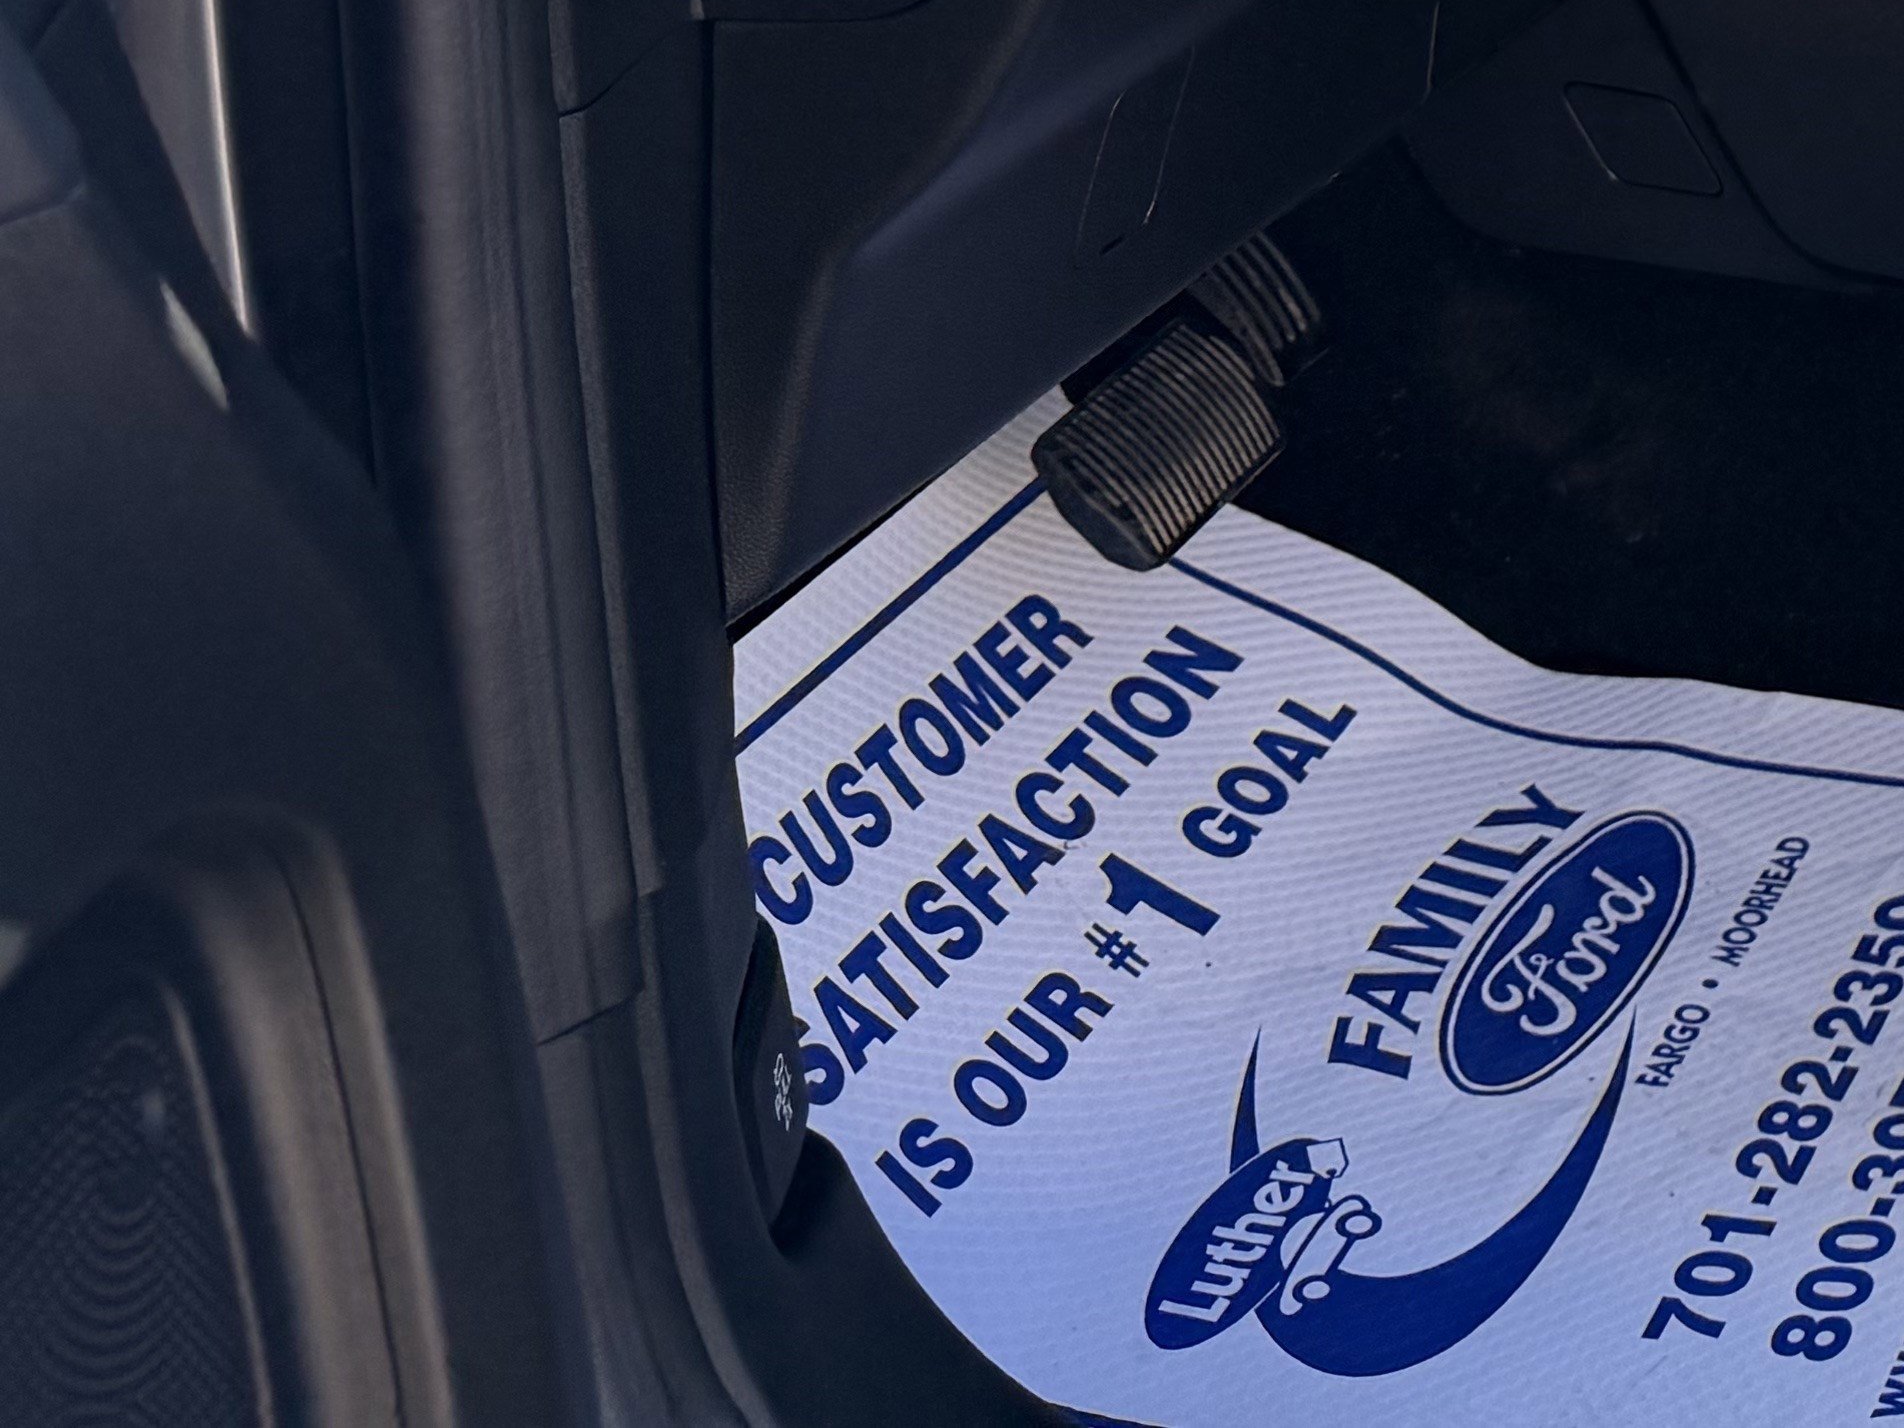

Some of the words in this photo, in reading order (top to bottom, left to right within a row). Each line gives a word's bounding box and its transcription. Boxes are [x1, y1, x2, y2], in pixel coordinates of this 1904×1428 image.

[750, 594, 1093, 928] CUSTOMER
[800, 623, 1247, 1105] SATISFACTION
[875, 1108, 972, 1217] IS
[952, 968, 1112, 1134] OUR
[1085, 853, 1221, 975] #1
[1181, 692, 1357, 859] GOAL
[1328, 786, 1585, 1078] FAMILY
[1481, 866, 1656, 1035] Ford
[1636, 1004, 1712, 1088] FARGO
[1712, 835, 1809, 968] MOORHEAD
[1158, 1157, 1311, 1330] Luther
